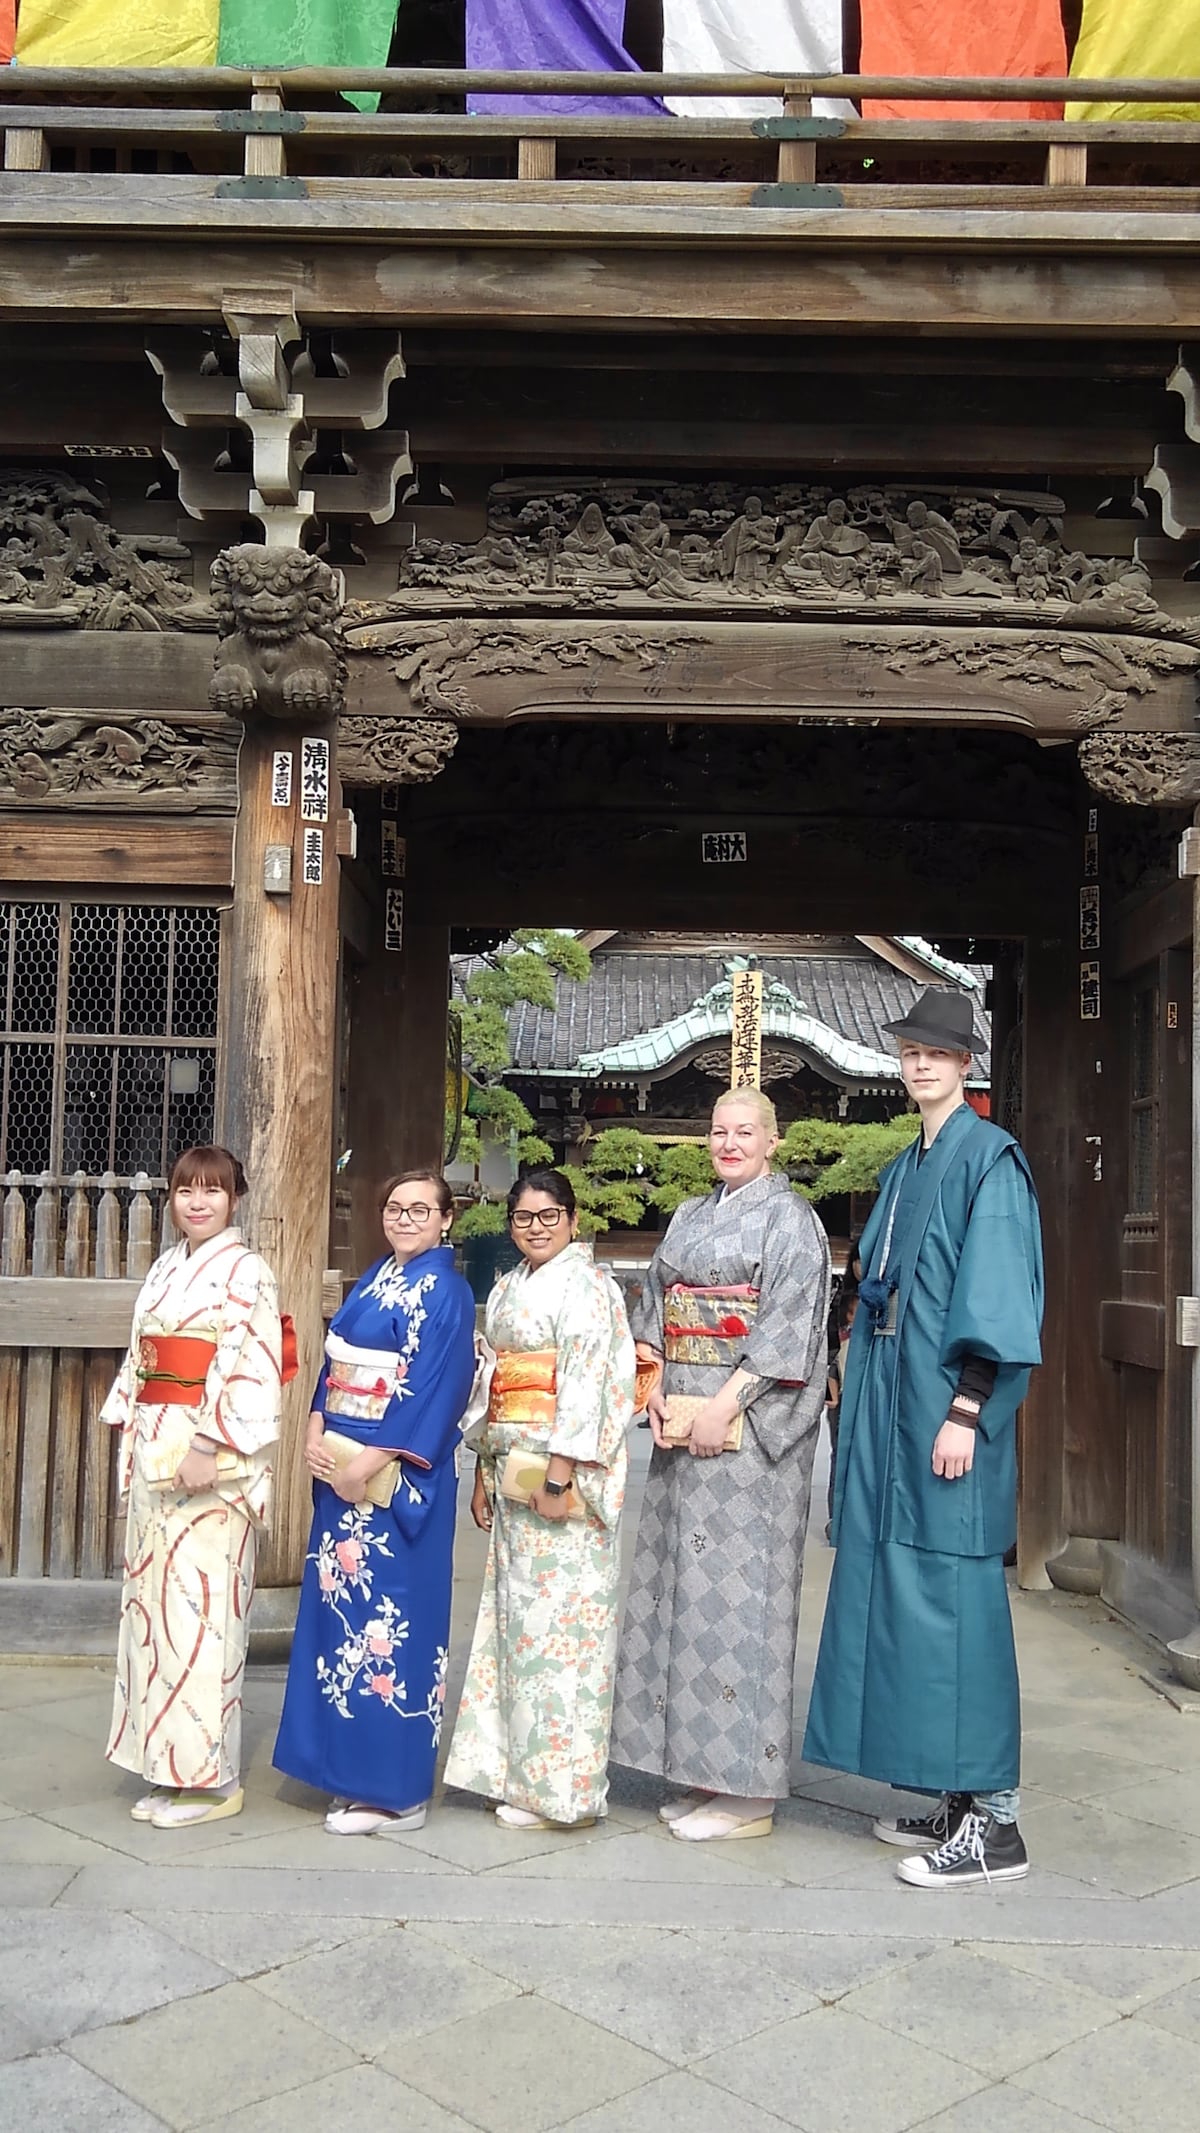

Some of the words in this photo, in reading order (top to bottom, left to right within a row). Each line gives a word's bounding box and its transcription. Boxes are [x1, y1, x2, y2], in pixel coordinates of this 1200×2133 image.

[303, 743, 328, 819] 清水祥
[306, 832, 321, 882] 圭太郎
[703, 834, 746, 861] 大村庵
